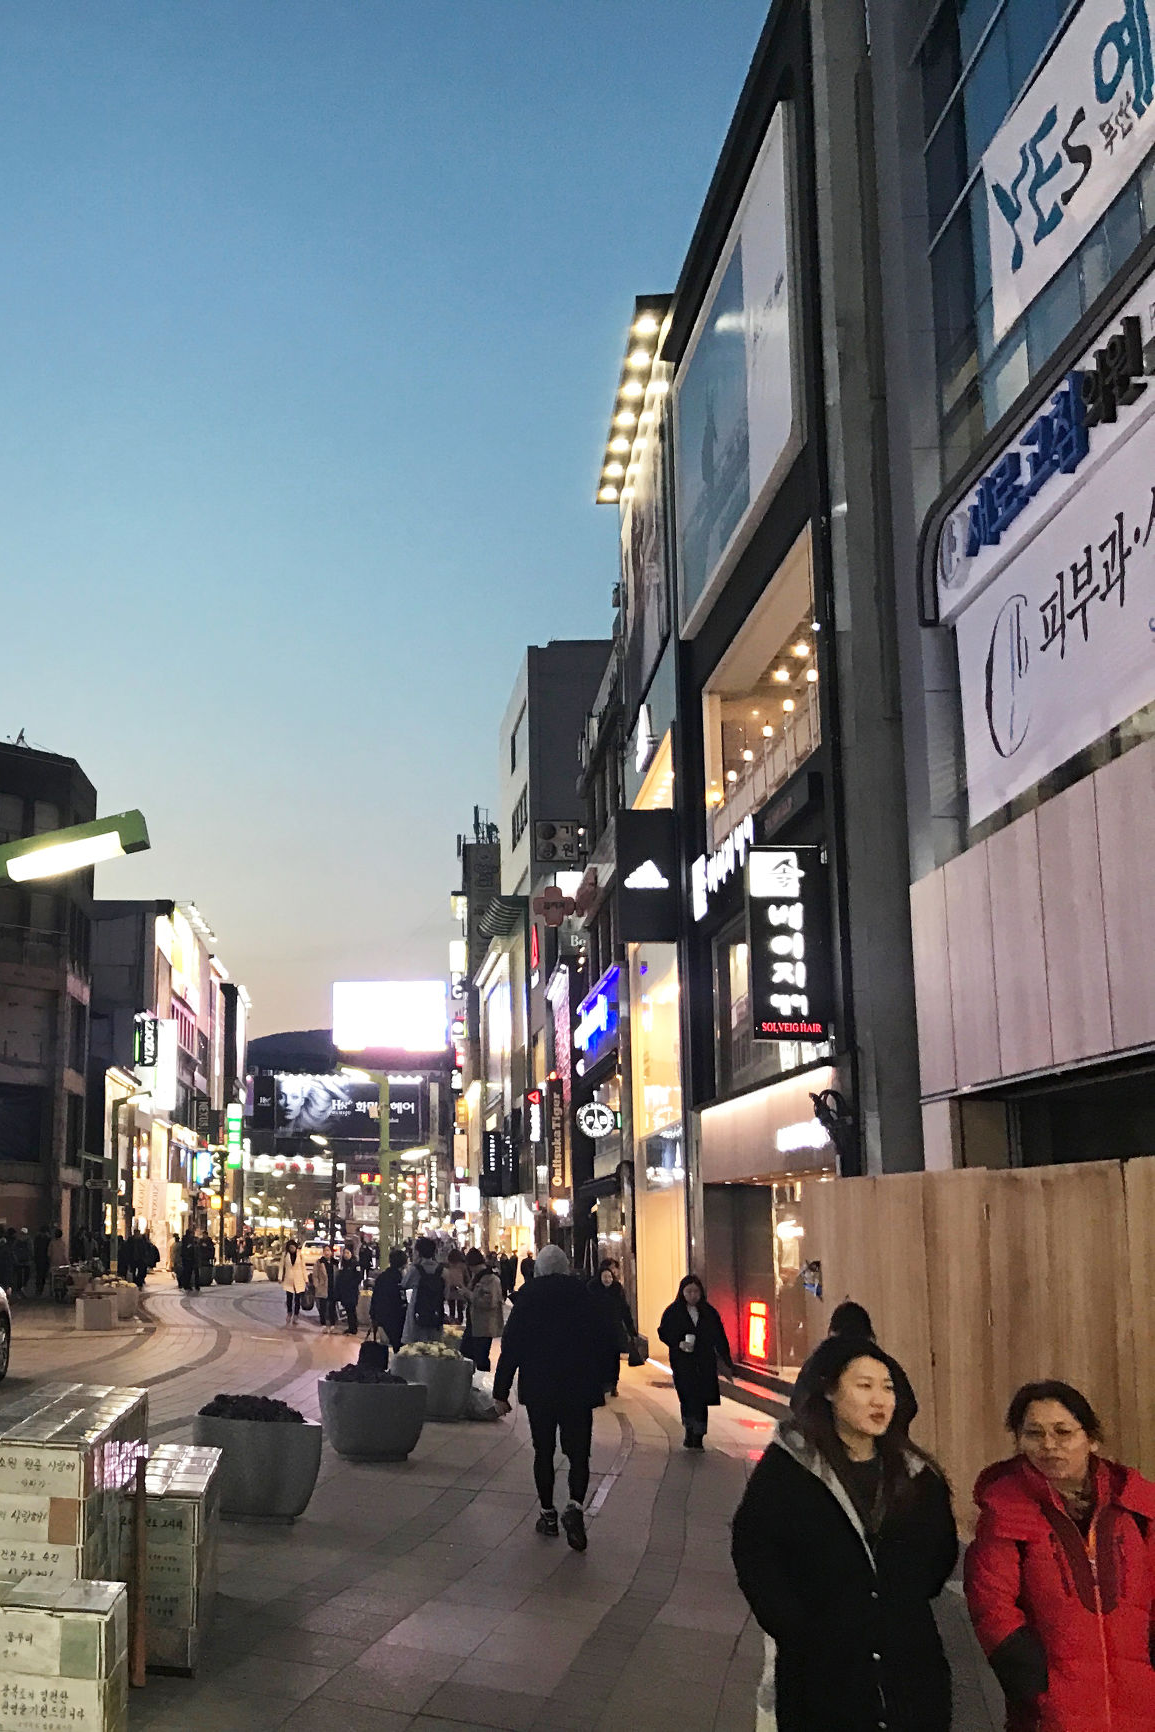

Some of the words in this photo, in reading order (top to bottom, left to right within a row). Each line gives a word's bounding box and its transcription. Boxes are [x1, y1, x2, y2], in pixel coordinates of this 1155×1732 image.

[991, 104, 1092, 274] YES
[762, 1021, 799, 1034] SOLVEIG
[800, 1021, 823, 1034] HAIR
[143, 1020, 155, 1065] ZIOZIA
[389, 1101, 415, 1115] 헤어
